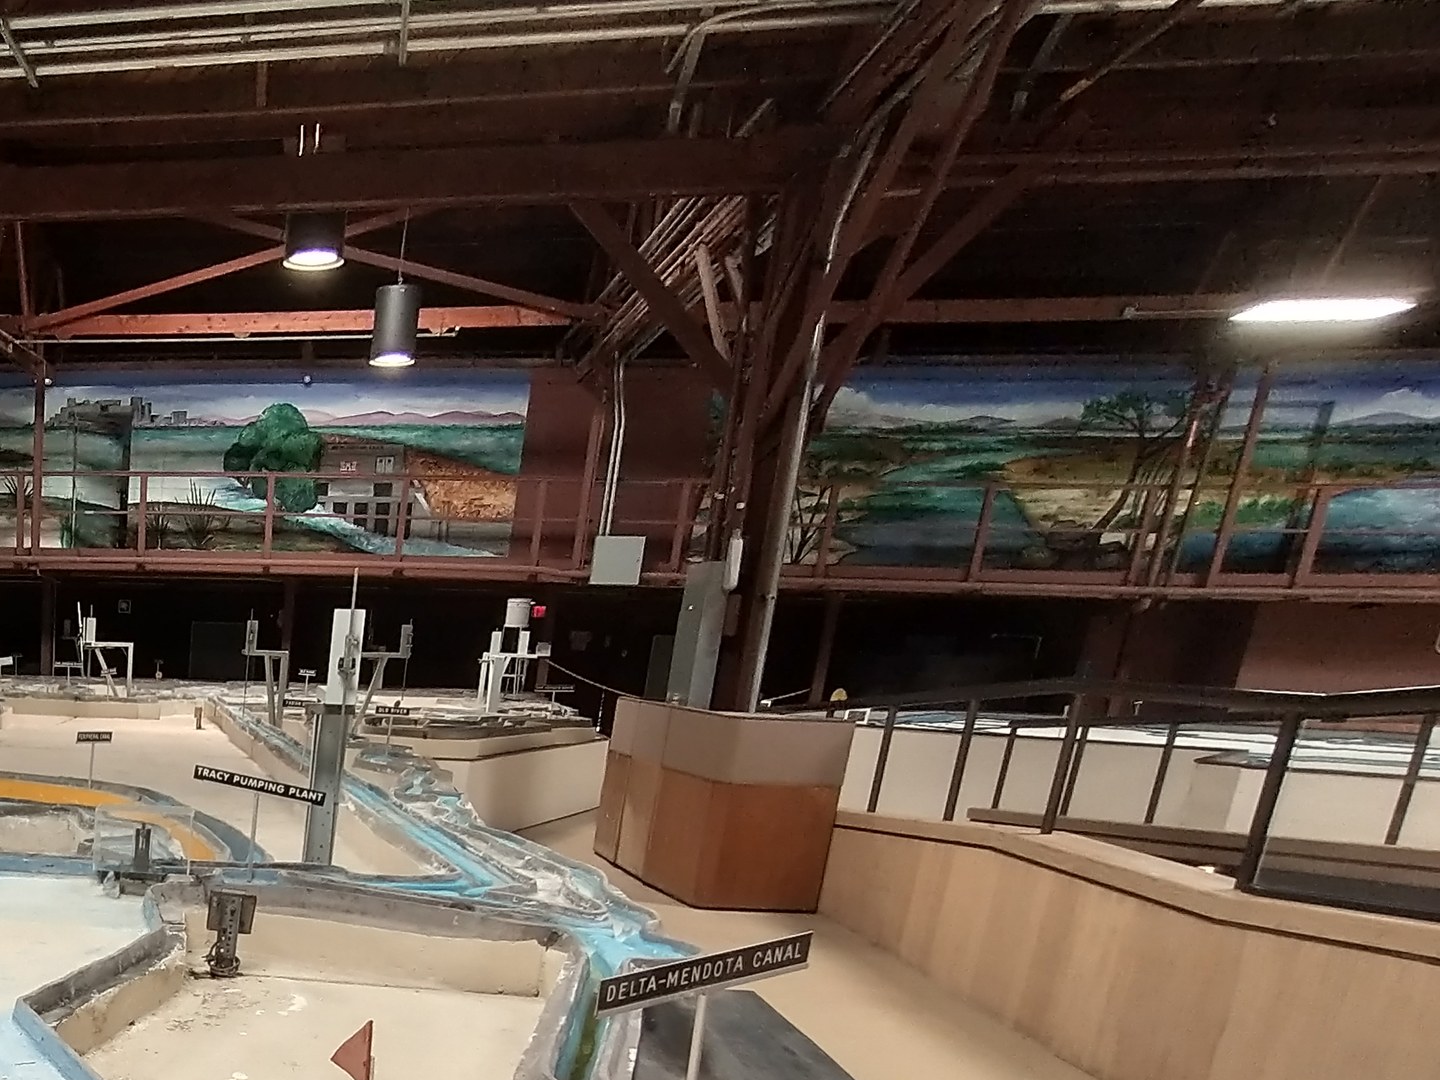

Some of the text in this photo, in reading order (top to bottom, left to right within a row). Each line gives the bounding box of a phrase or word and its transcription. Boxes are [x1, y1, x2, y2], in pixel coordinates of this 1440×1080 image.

[196, 767, 324, 802] TRACY PUMPING PLANT
[606, 941, 803, 1002] DELTA-MENDOTA CANAL
